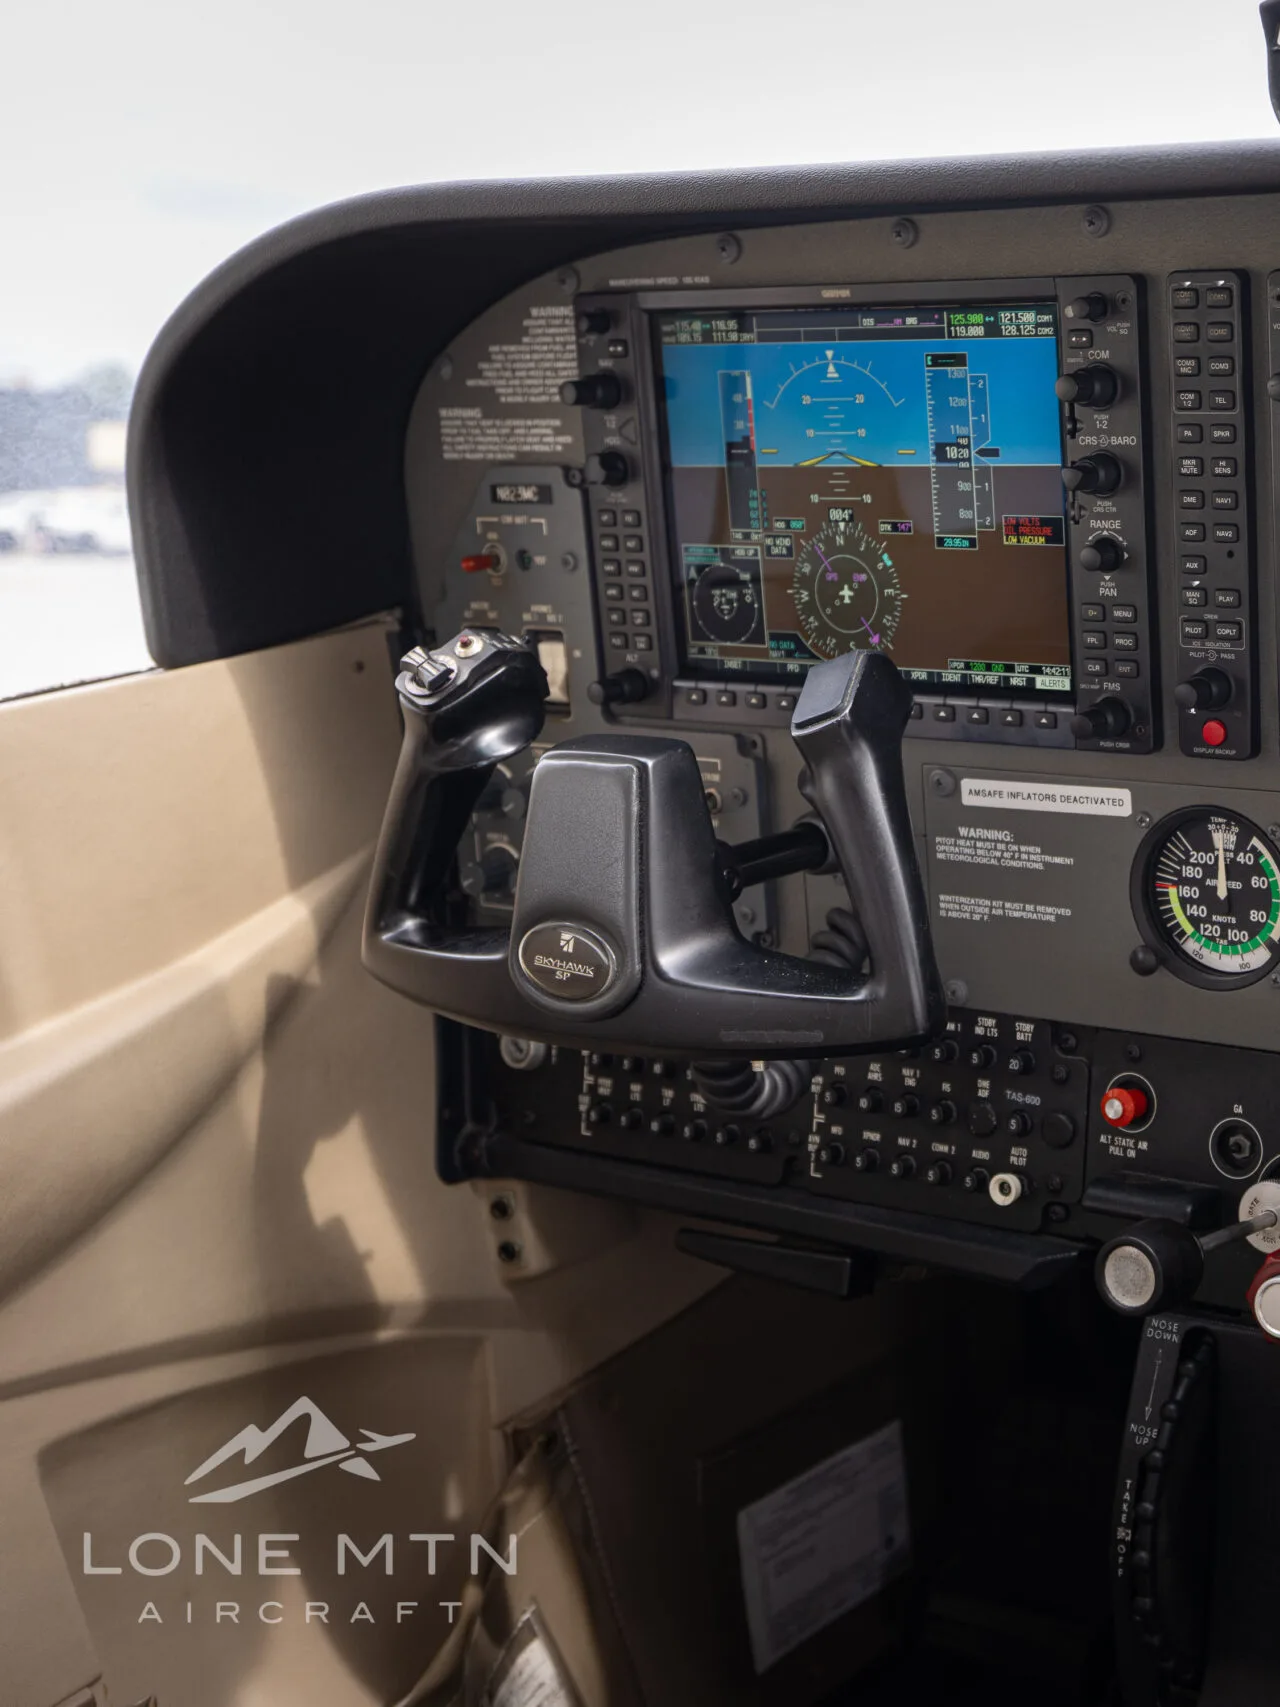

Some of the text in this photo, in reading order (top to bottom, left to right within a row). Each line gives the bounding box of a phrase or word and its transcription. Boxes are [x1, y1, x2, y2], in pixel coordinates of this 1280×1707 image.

[950, 326, 984, 336] 119.000
[1001, 326, 1035, 336] 128.125
[1088, 350, 1110, 360] COM
[1079, 436, 1136, 445] CRS BARO
[1090, 520, 1121, 529] RANGE
[1004, 527, 1052, 536] OIL PRESSURE
[1100, 588, 1117, 597] PAN
[1010, 677, 1026, 686] NRST
[1104, 682, 1120, 691] FMS
[968, 788, 1124, 807] AMSAFE INFLATORS DEACTIVATED
[958, 826, 1014, 842] WARNING:
[1190, 852, 1214, 864] 200
[1237, 852, 1253, 864] 40
[1183, 866, 1202, 878] 180
[1251, 877, 1268, 889] 60
[1179, 885, 1199, 898] 160
[939, 903, 1056, 922] WHEN OUTSIDE AIR TEMPERATURE
[1187, 904, 1207, 917] 140
[1212, 915, 1236, 924] KNOTS
[1250, 911, 1266, 923] 80
[1200, 924, 1220, 936] 120
[1228, 930, 1248, 942] 100
[534, 955, 594, 975] SKYHAWK
[555, 970, 570, 980] SP
[1015, 1022, 1034, 1033] STDBY
[1016, 1031, 1032, 1042] BATT
[1006, 1090, 1041, 1106] TAS-600
[1233, 1104, 1243, 1114] GA
[1100, 1134, 1148, 1150] ALT STATIC AIR
[1109, 1146, 1136, 1158] PULL ON
[1151, 1318, 1179, 1333] NOSE
[1146, 1328, 1180, 1343] DOWN
[1130, 1424, 1158, 1438] NOSE
[1135, 1436, 1149, 1446] UP
